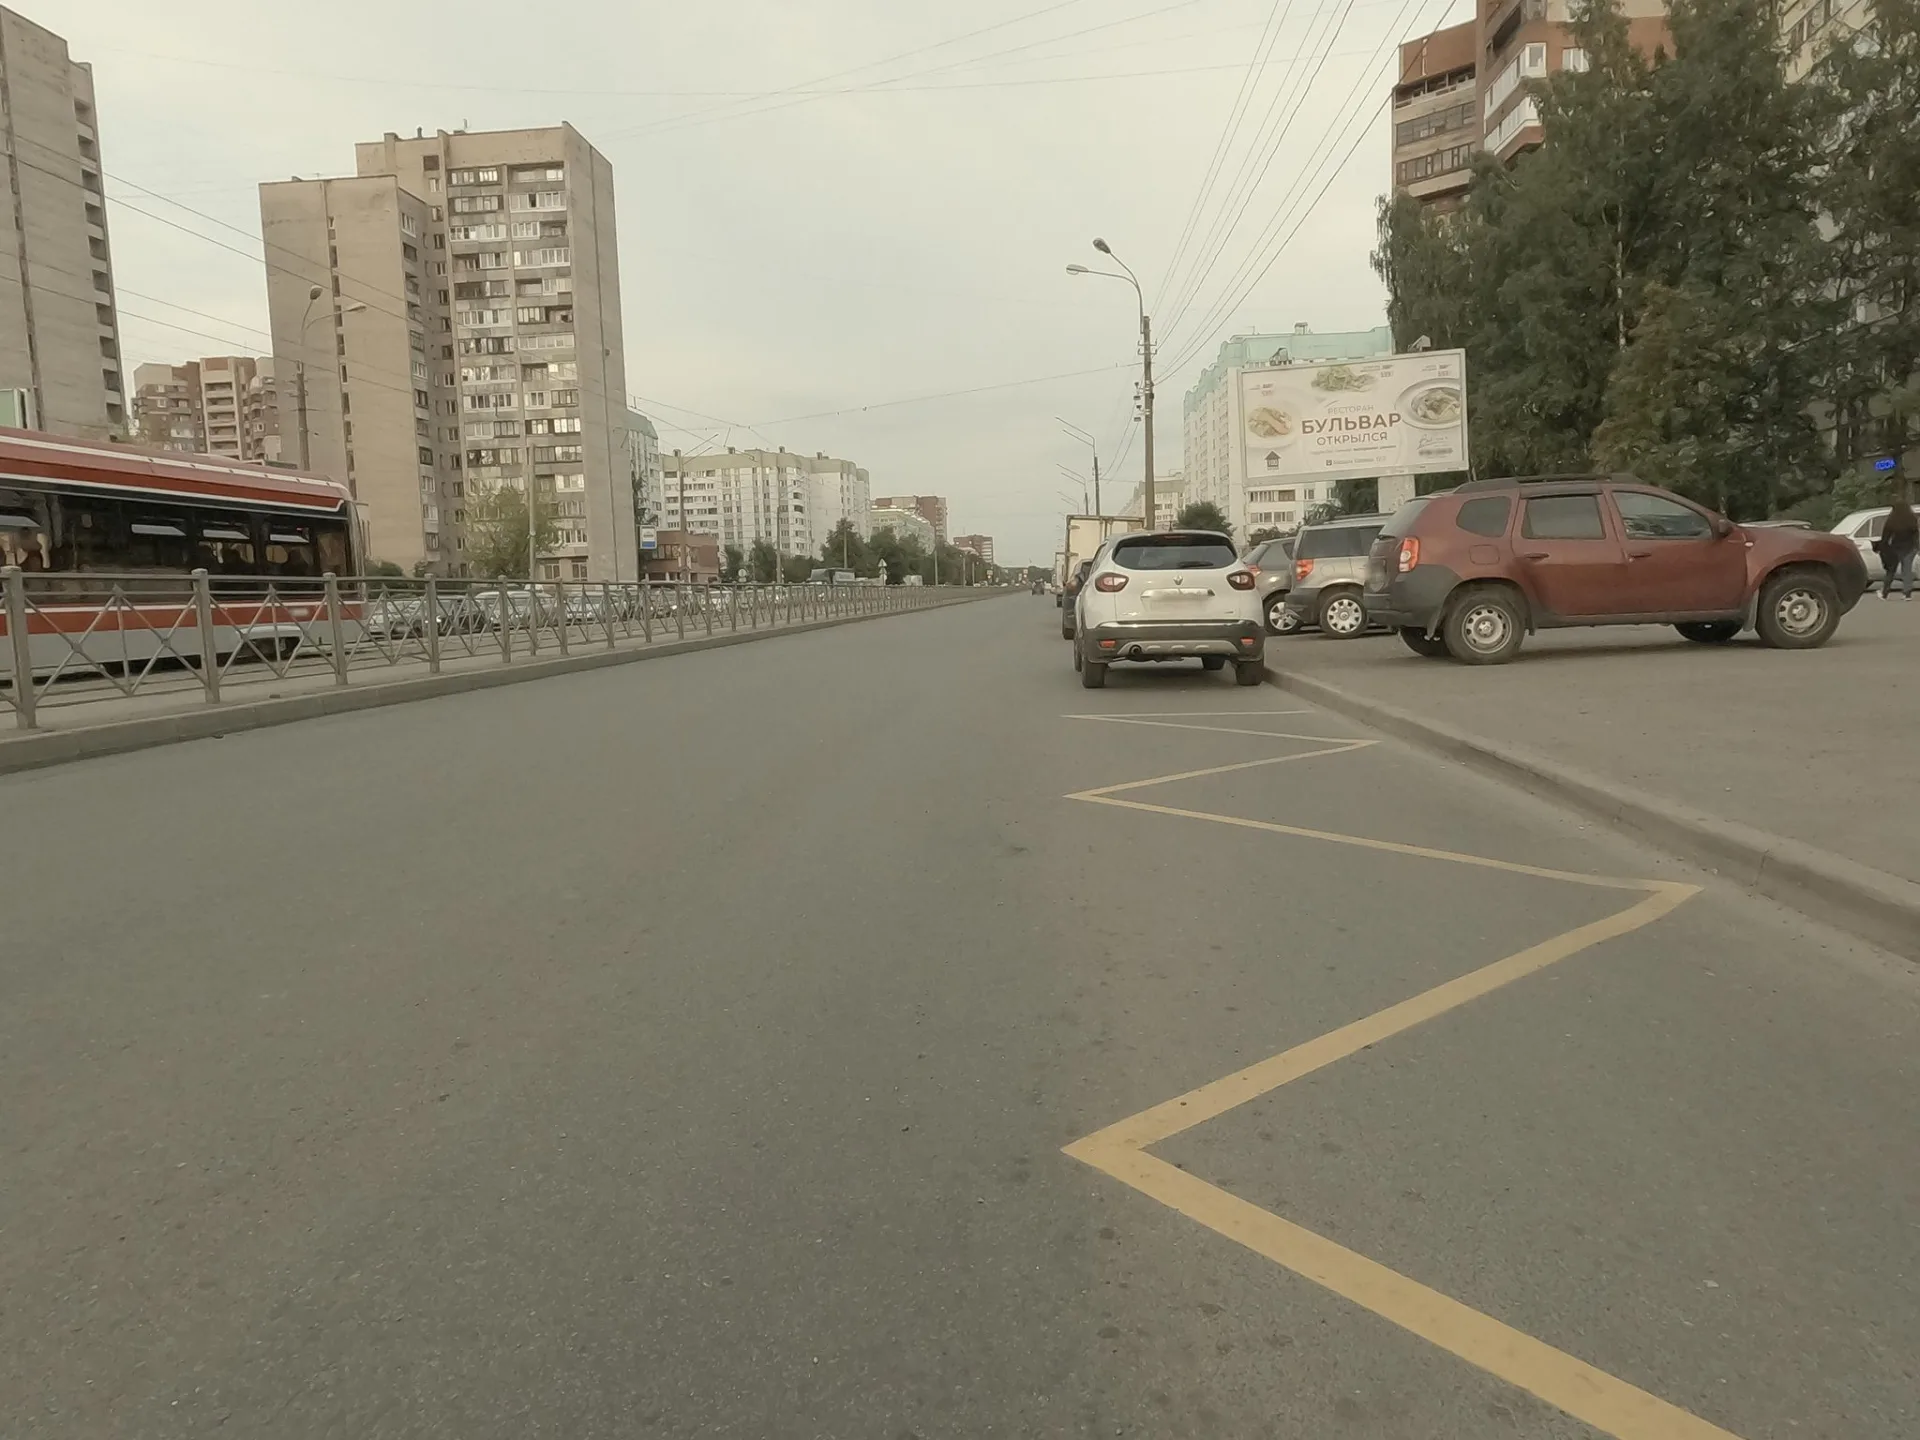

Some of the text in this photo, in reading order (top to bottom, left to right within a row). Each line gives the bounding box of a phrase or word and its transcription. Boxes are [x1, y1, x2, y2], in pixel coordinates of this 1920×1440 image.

[1327, 405, 1374, 414] РЕСТОРАН
[1302, 412, 1402, 434] БУЛЬВАР
[1316, 431, 1388, 446] ОТКРЫЛСЯ
